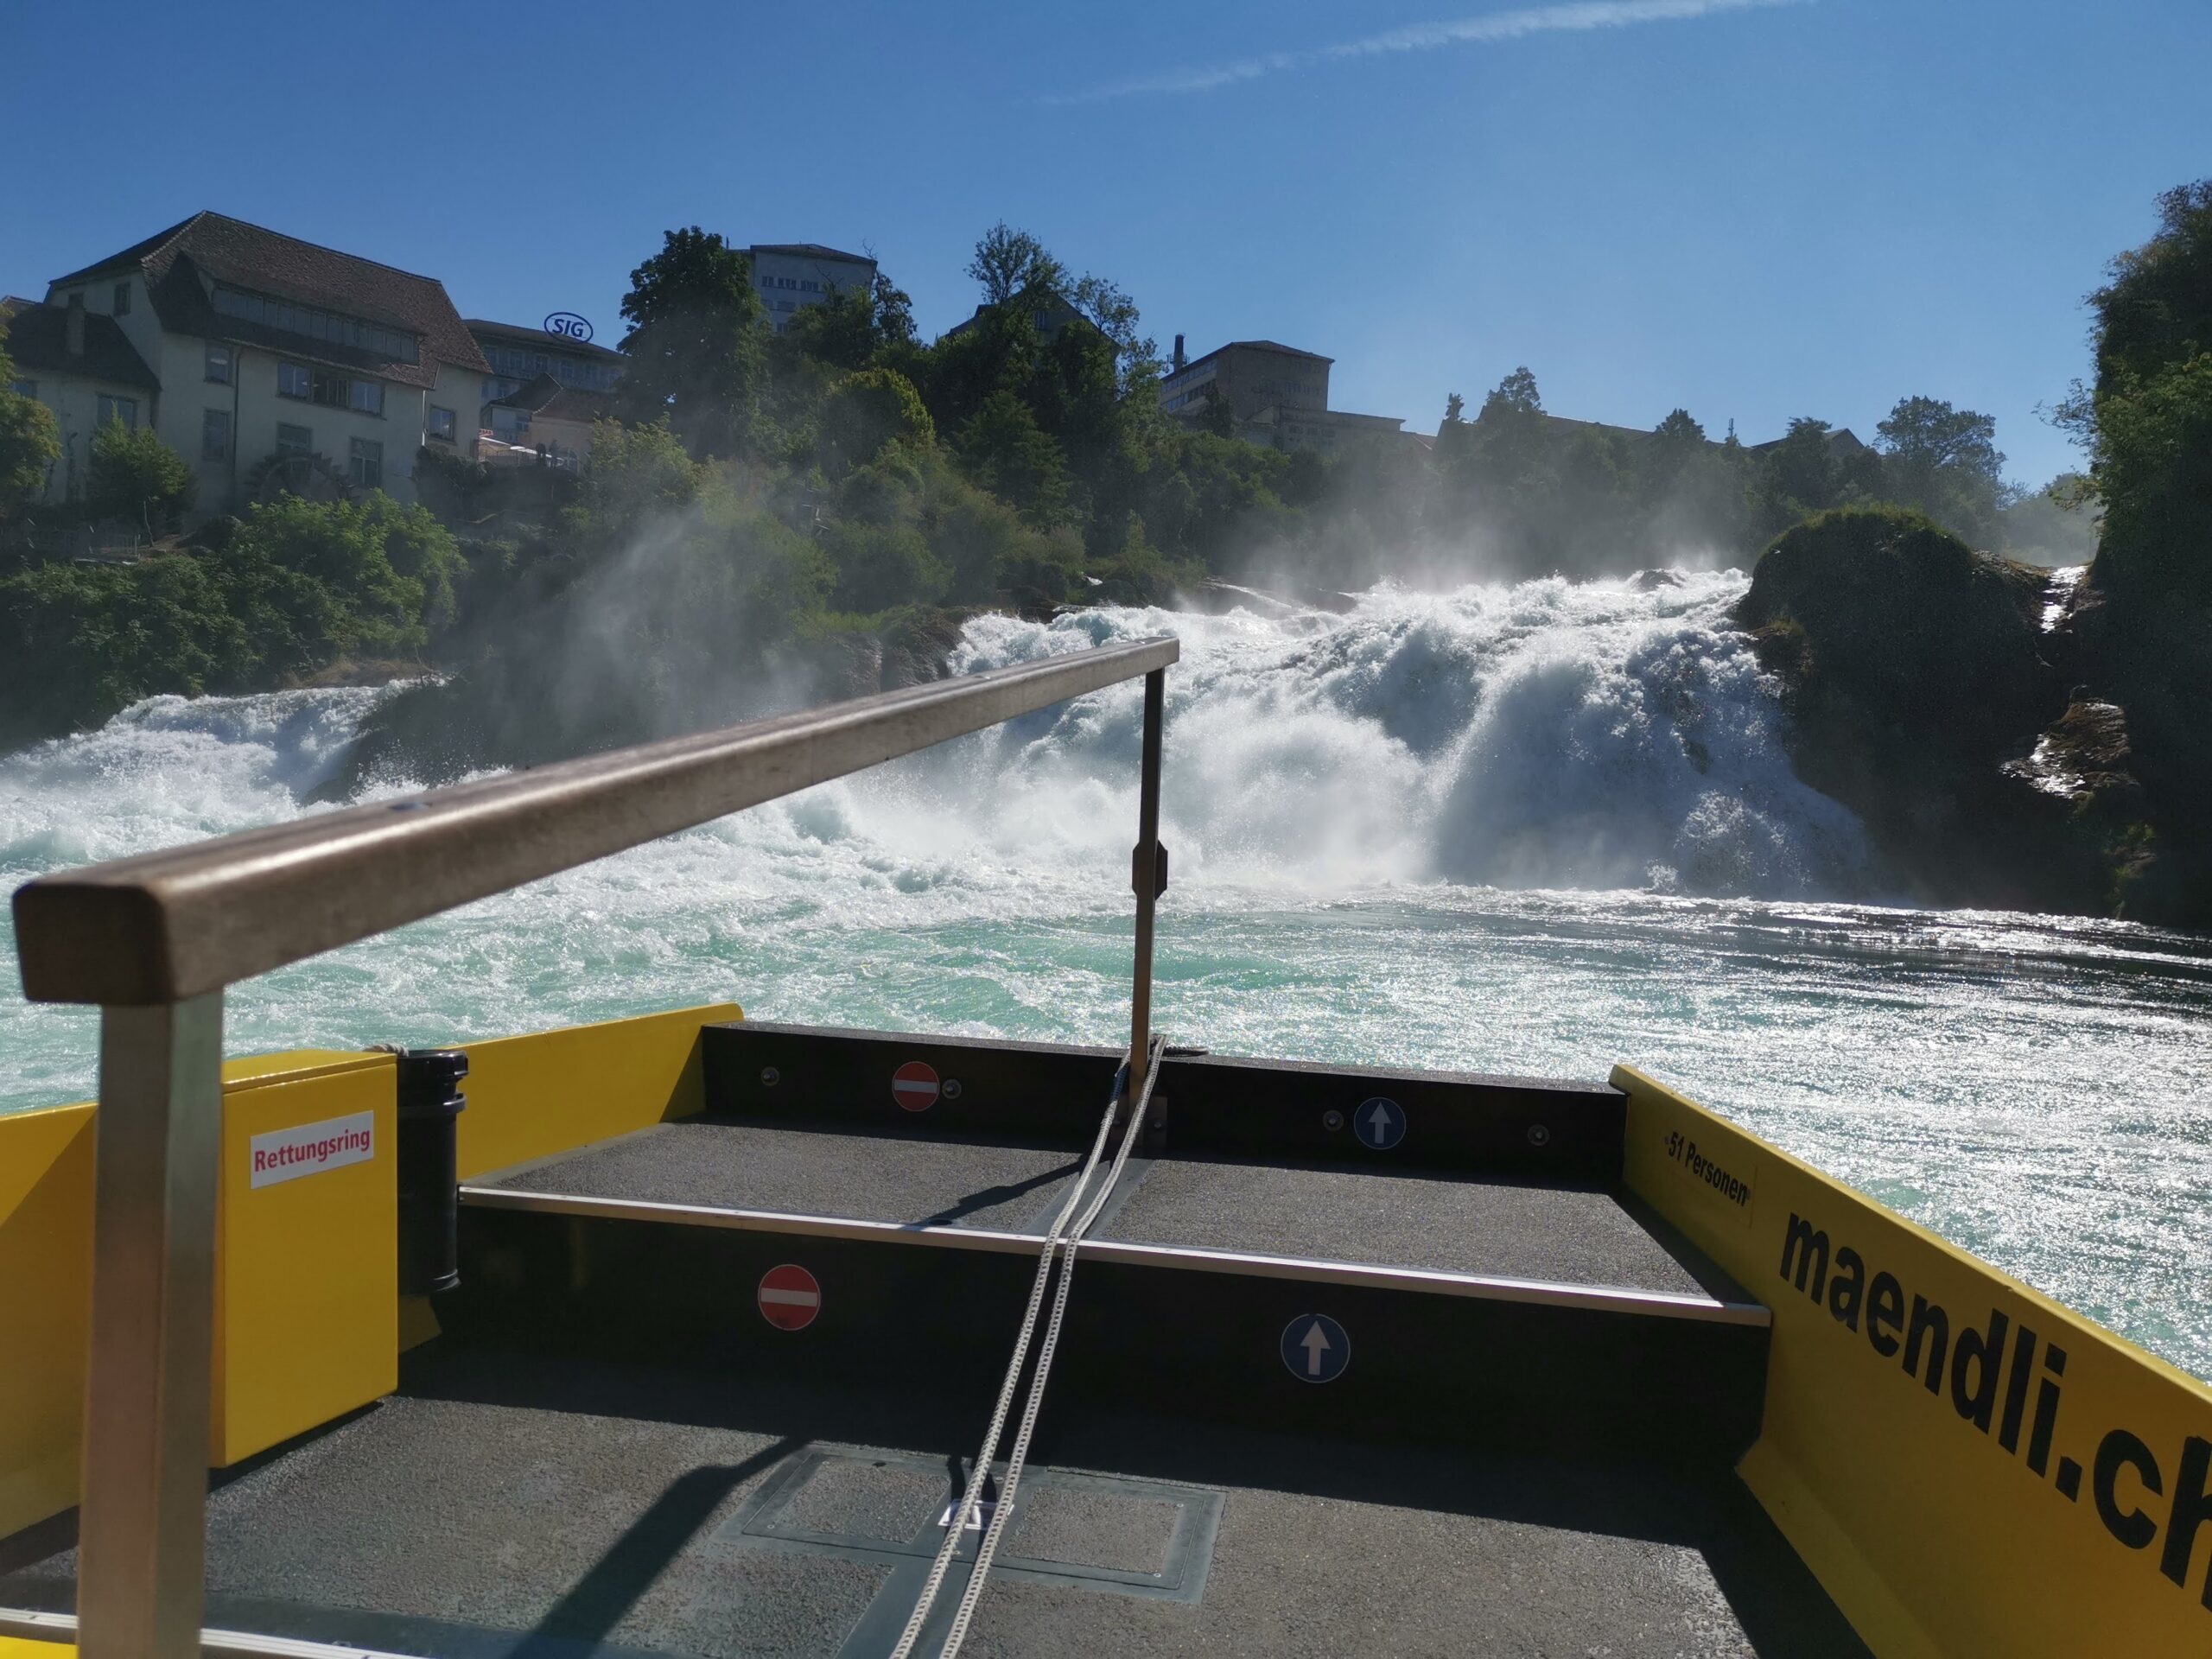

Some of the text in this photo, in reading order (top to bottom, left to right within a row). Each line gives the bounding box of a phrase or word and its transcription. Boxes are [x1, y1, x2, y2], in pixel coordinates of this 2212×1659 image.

[552, 318, 584, 338] SIG
[255, 1128, 371, 1172] Rettungsring
[1668, 1130, 1749, 1207] 51 Personen
